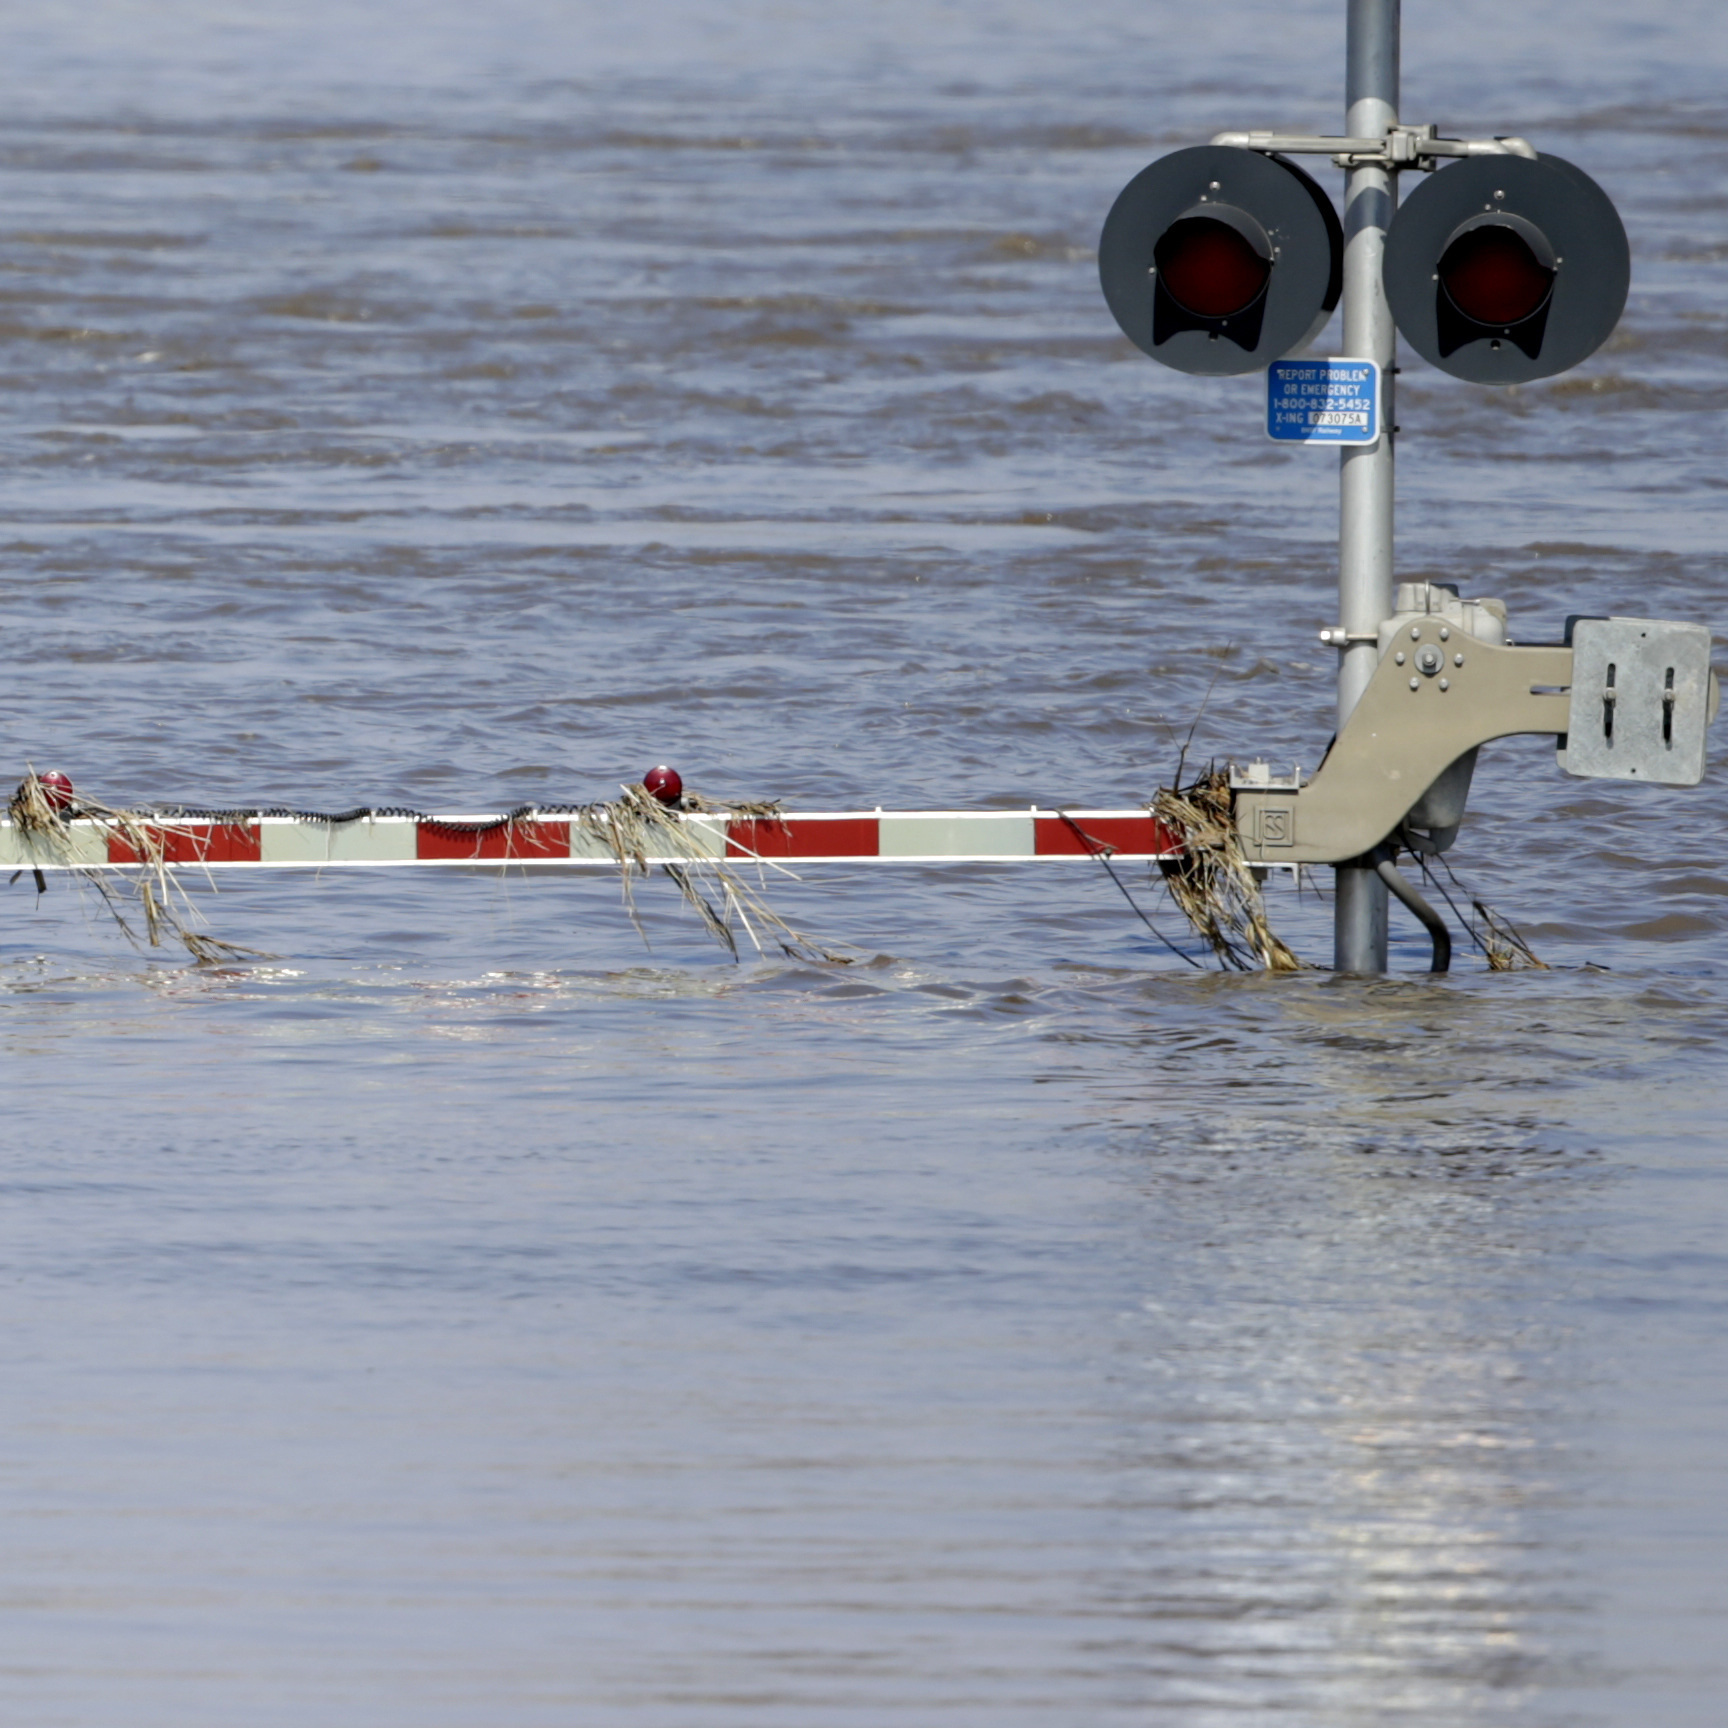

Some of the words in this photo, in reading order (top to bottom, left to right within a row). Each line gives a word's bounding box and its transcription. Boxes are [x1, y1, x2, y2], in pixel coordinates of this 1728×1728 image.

[1278, 369, 1317, 381] REPORT
[1284, 383, 1298, 395] OR
[1301, 384, 1361, 396] EMERGENCY
[1274, 398, 1371, 410] 1-800-832-5452
[1276, 413, 1304, 424] X-ING
[1313, 413, 1362, 424] 073075A
